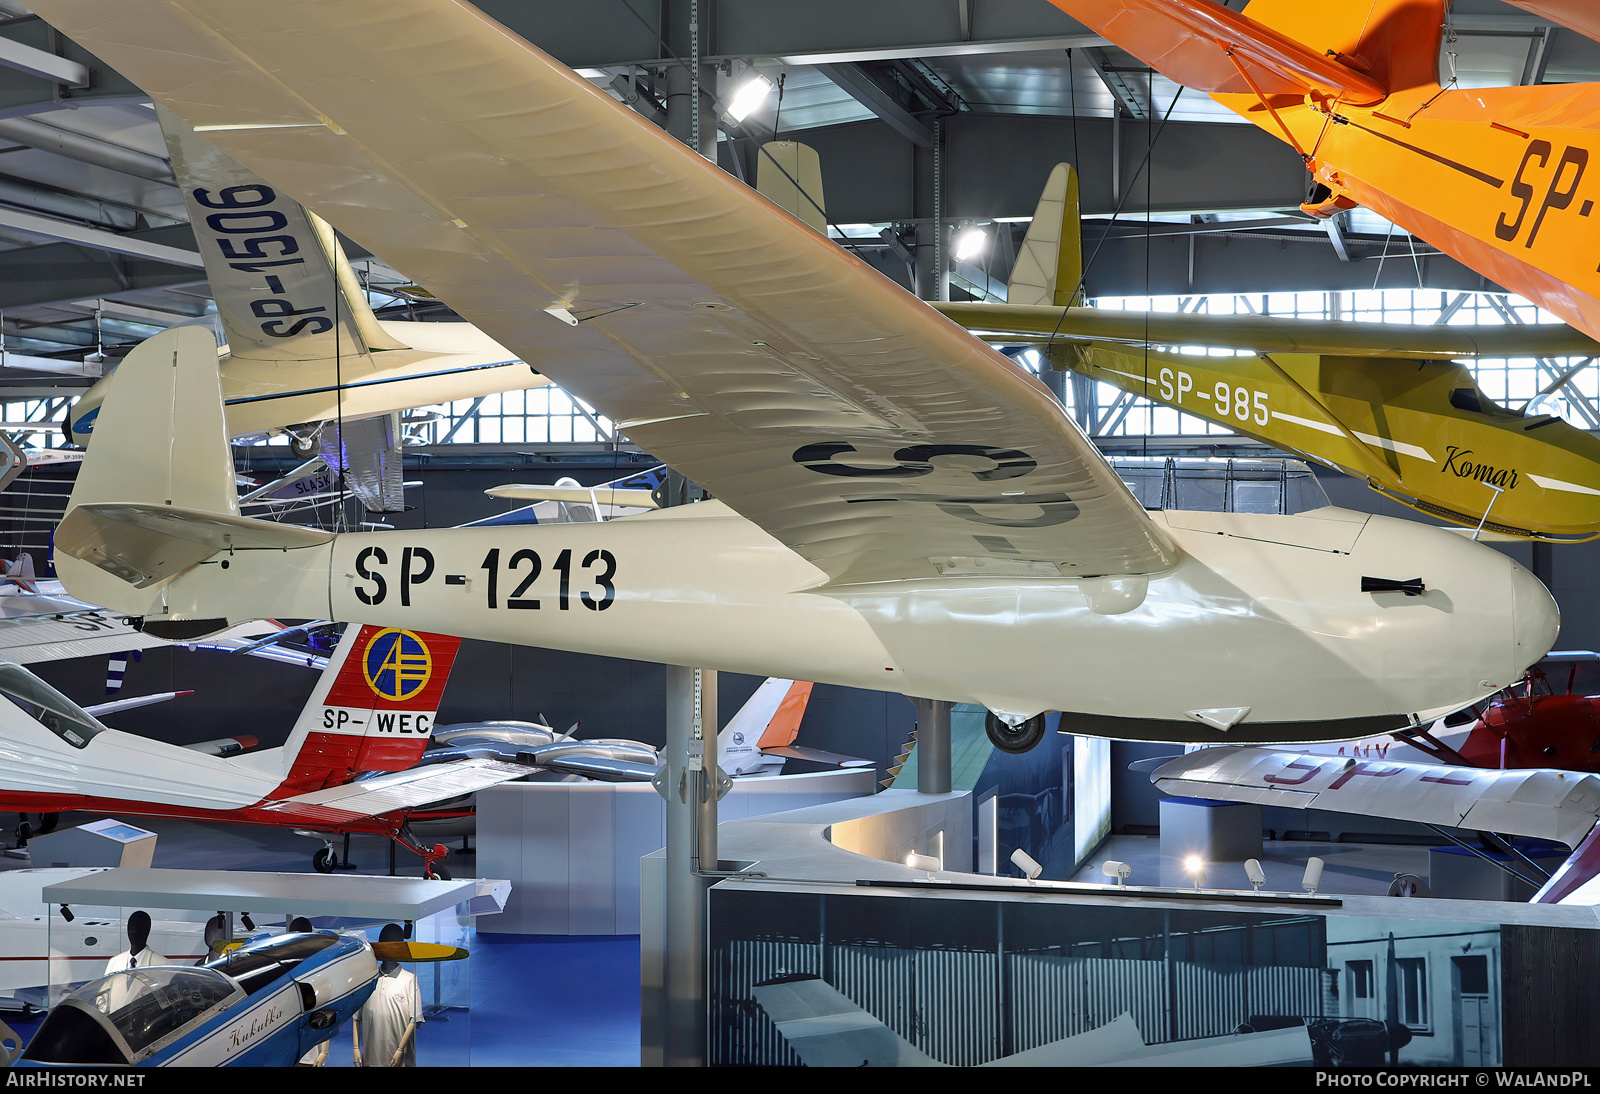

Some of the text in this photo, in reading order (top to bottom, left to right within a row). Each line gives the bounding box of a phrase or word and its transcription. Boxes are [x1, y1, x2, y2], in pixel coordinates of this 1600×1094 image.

[1495, 139, 1600, 273] SP-
[192, 184, 334, 338] SP-1506
[1160, 367, 1269, 427] SP-985
[1441, 446, 1519, 490] Komar
[354, 546, 617, 612] SP-1213
